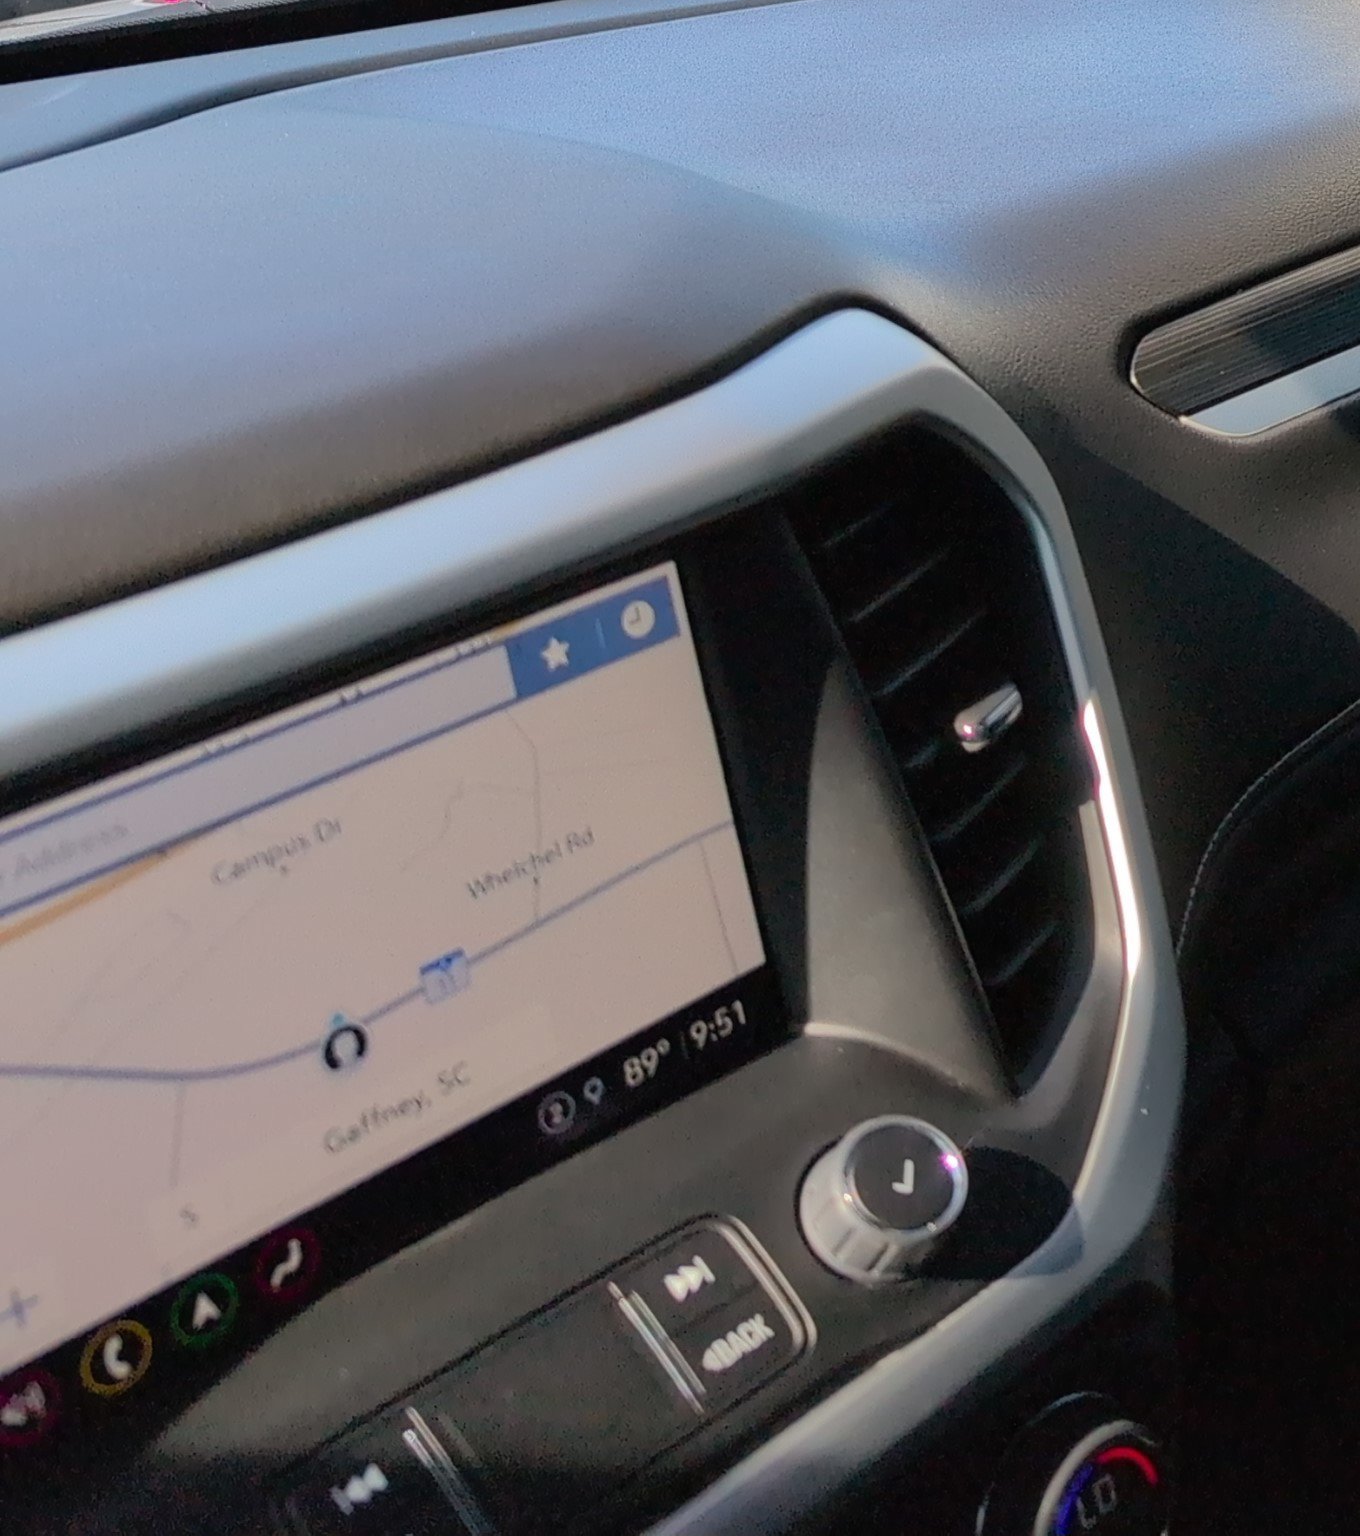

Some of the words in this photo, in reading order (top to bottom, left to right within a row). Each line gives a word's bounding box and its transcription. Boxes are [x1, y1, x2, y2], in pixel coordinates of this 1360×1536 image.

[210, 833, 311, 885] Campus
[565, 826, 595, 855] Rd
[689, 998, 747, 1051] 9:51
[436, 1060, 471, 1096] SC
[622, 1037, 672, 1089] 89°
[710, 1312, 776, 1370] BACK
